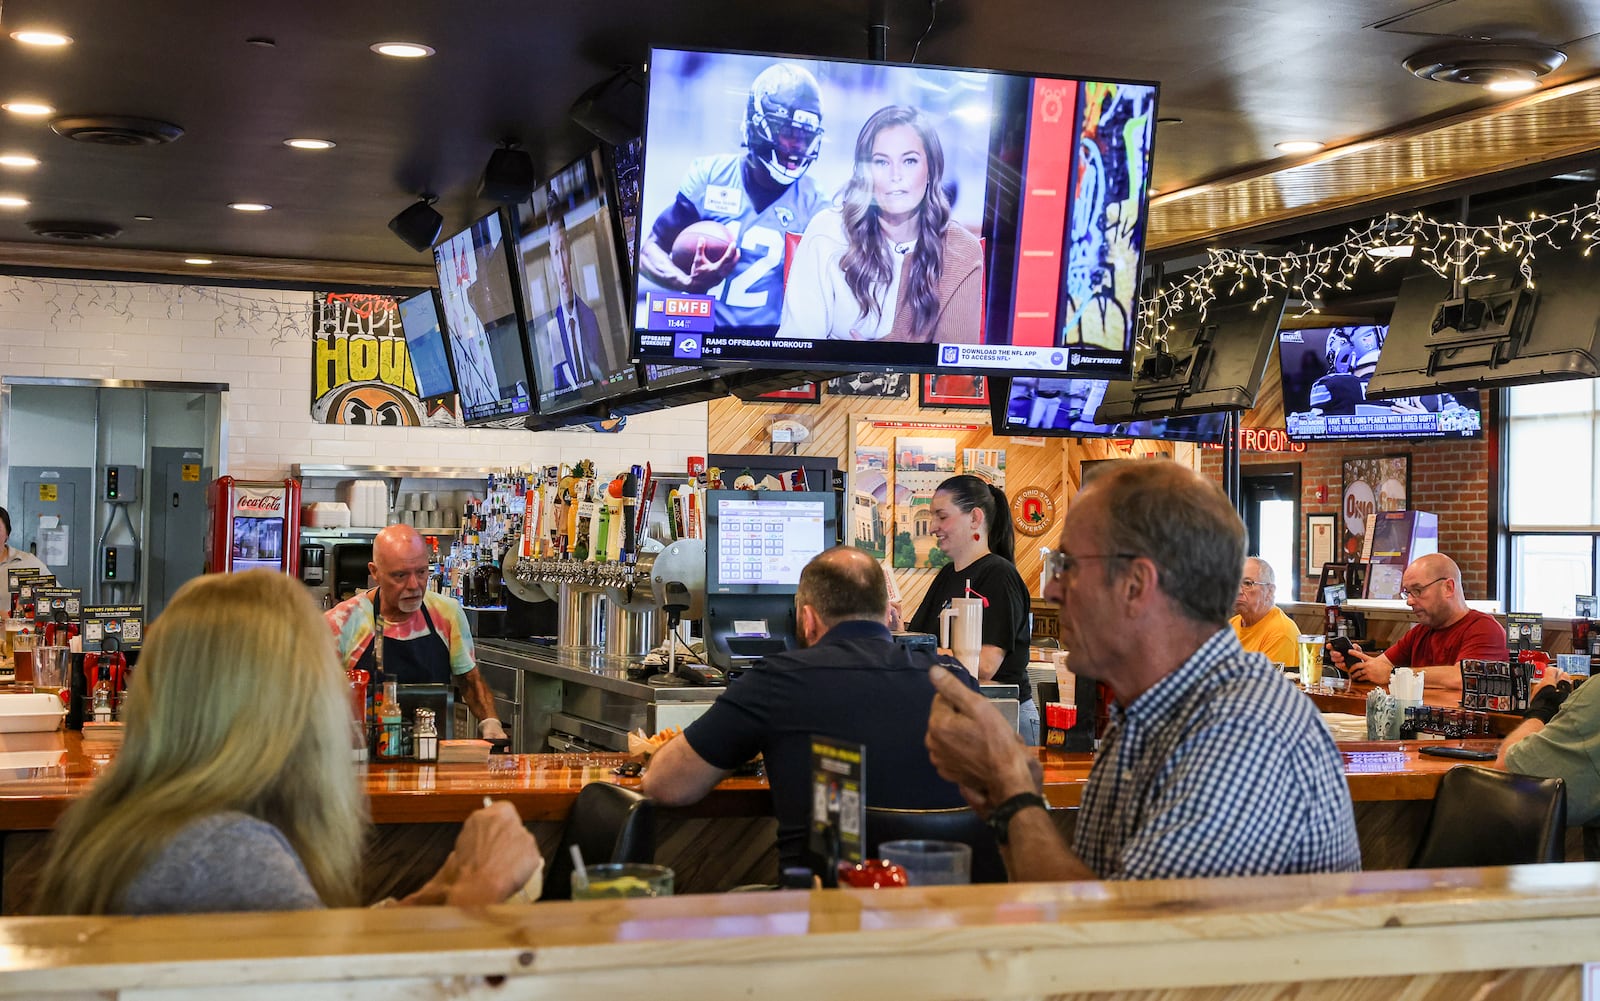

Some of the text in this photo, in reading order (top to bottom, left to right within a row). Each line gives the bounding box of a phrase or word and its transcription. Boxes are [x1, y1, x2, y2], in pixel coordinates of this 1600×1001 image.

[706, 220, 783, 308] 2
[668, 300, 709, 314] GMFB
[316, 298, 403, 337] HAPP
[668, 319, 685, 328] 11:44
[701, 346, 721, 355] 16-18
[706, 338, 813, 349] RAMS OFFSEASON WORKOUTS
[1080, 356, 1123, 364] NETWORK
[1327, 417, 1341, 425] HAVE
[1341, 416, 1351, 424] THE
[1351, 416, 1367, 424] LIONS
[1367, 416, 1387, 424] PEAKED
[1387, 415, 1402, 424] WITH
[1402, 415, 1418, 423] JARED
[237, 495, 283, 511] Coca-Cola
[1014, 489, 1053, 511] THE OHIO STATE
[1015, 516, 1050, 532] UNIVERSITY
